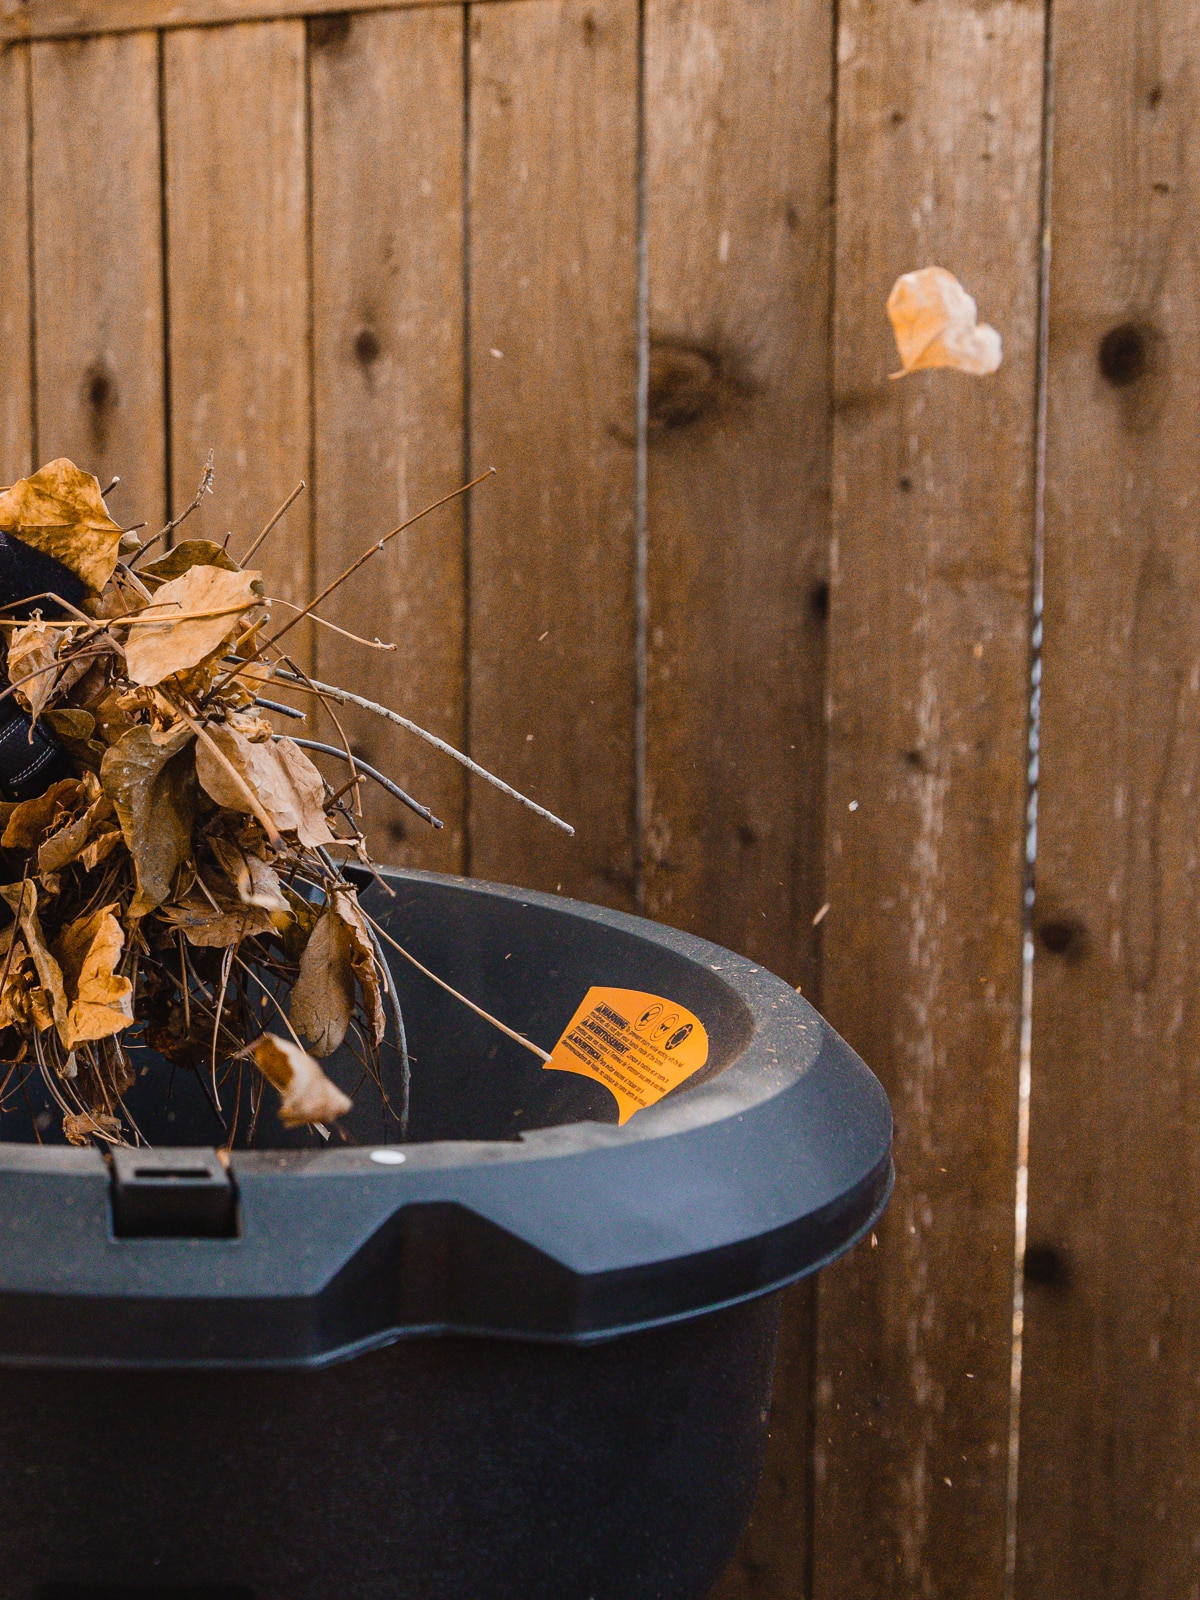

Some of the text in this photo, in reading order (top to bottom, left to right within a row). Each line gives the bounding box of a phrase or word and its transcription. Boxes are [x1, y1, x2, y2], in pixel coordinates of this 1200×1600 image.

[599, 1006, 629, 1030] WARNING
[571, 1034, 602, 1060] ADVERTENCIA
[586, 1020, 629, 1055] AVERTISSEMENT
